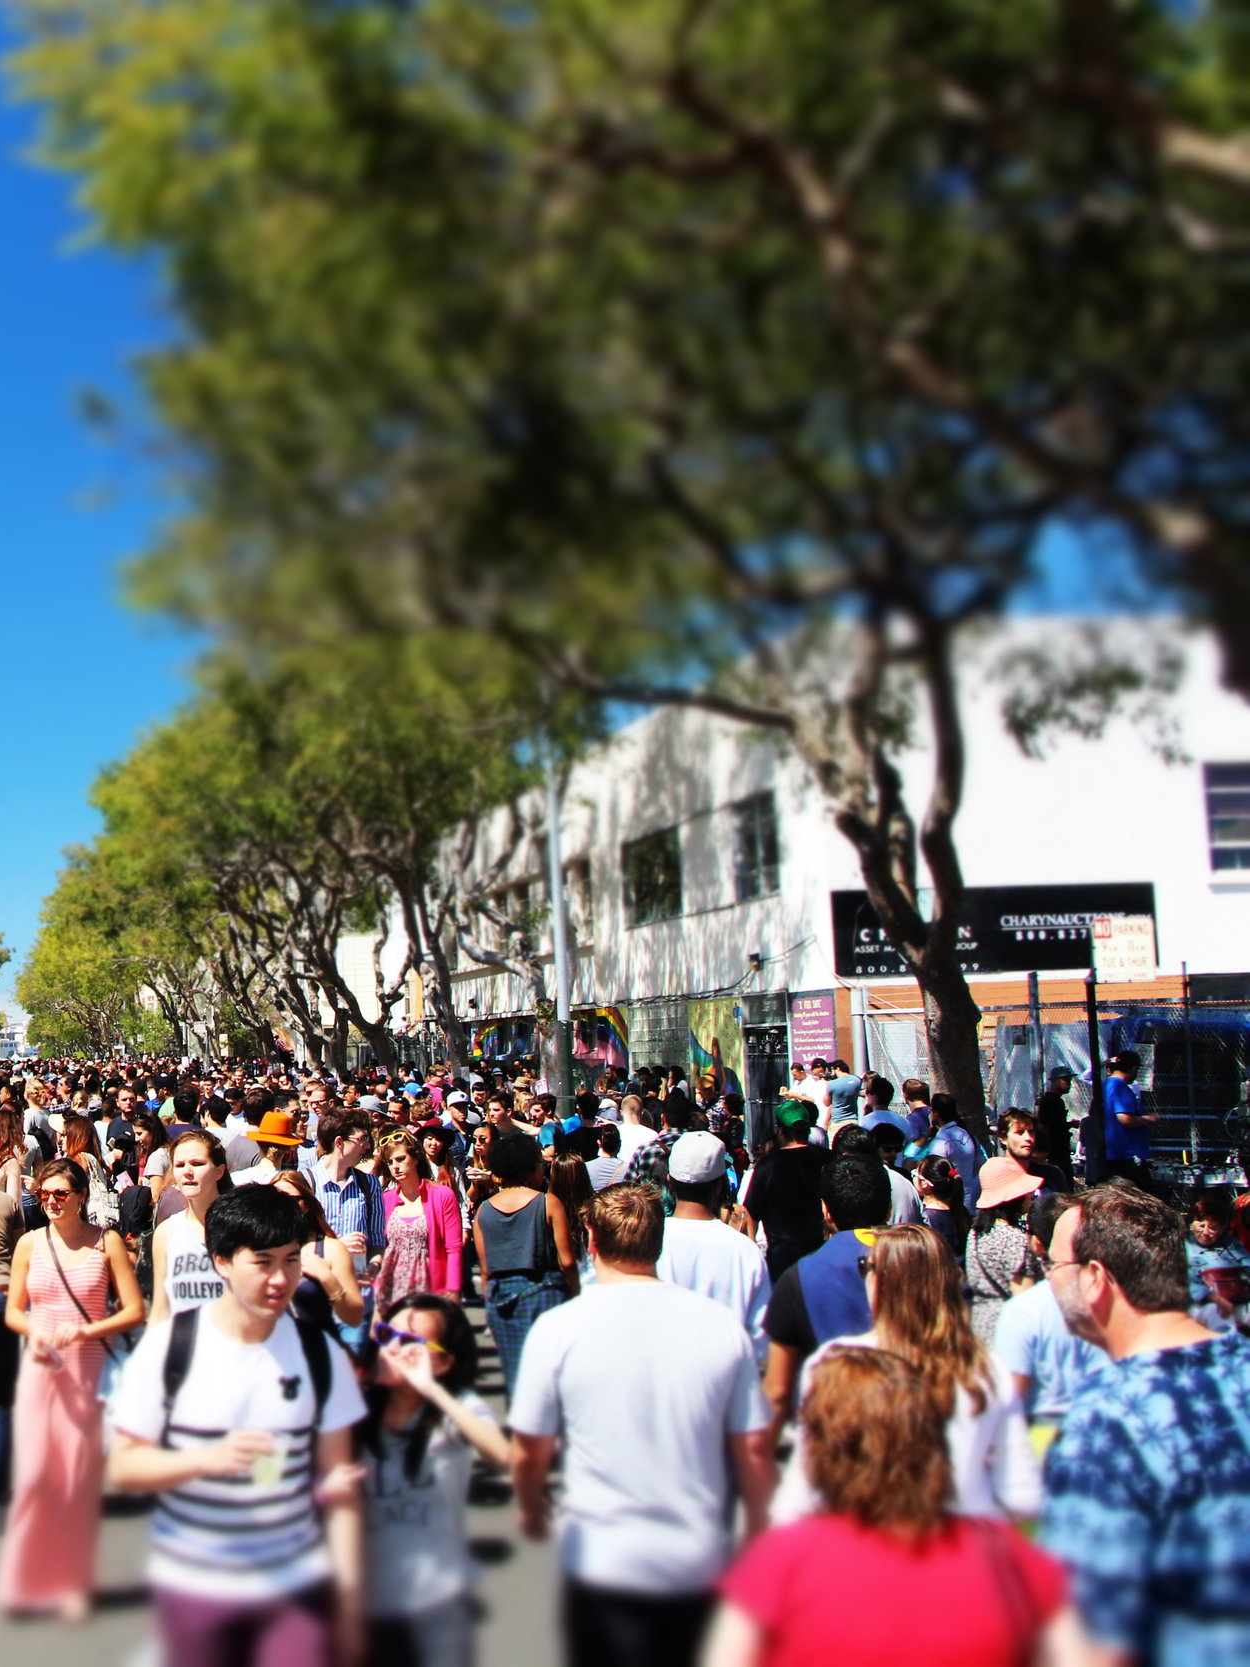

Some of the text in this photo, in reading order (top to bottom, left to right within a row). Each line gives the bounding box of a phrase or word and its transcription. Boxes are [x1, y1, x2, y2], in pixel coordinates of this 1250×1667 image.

[1000, 912, 1151, 927] CHARYNAUCTIONS
[854, 944, 880, 954] ASSET
[1102, 957, 1116, 969] TUE
